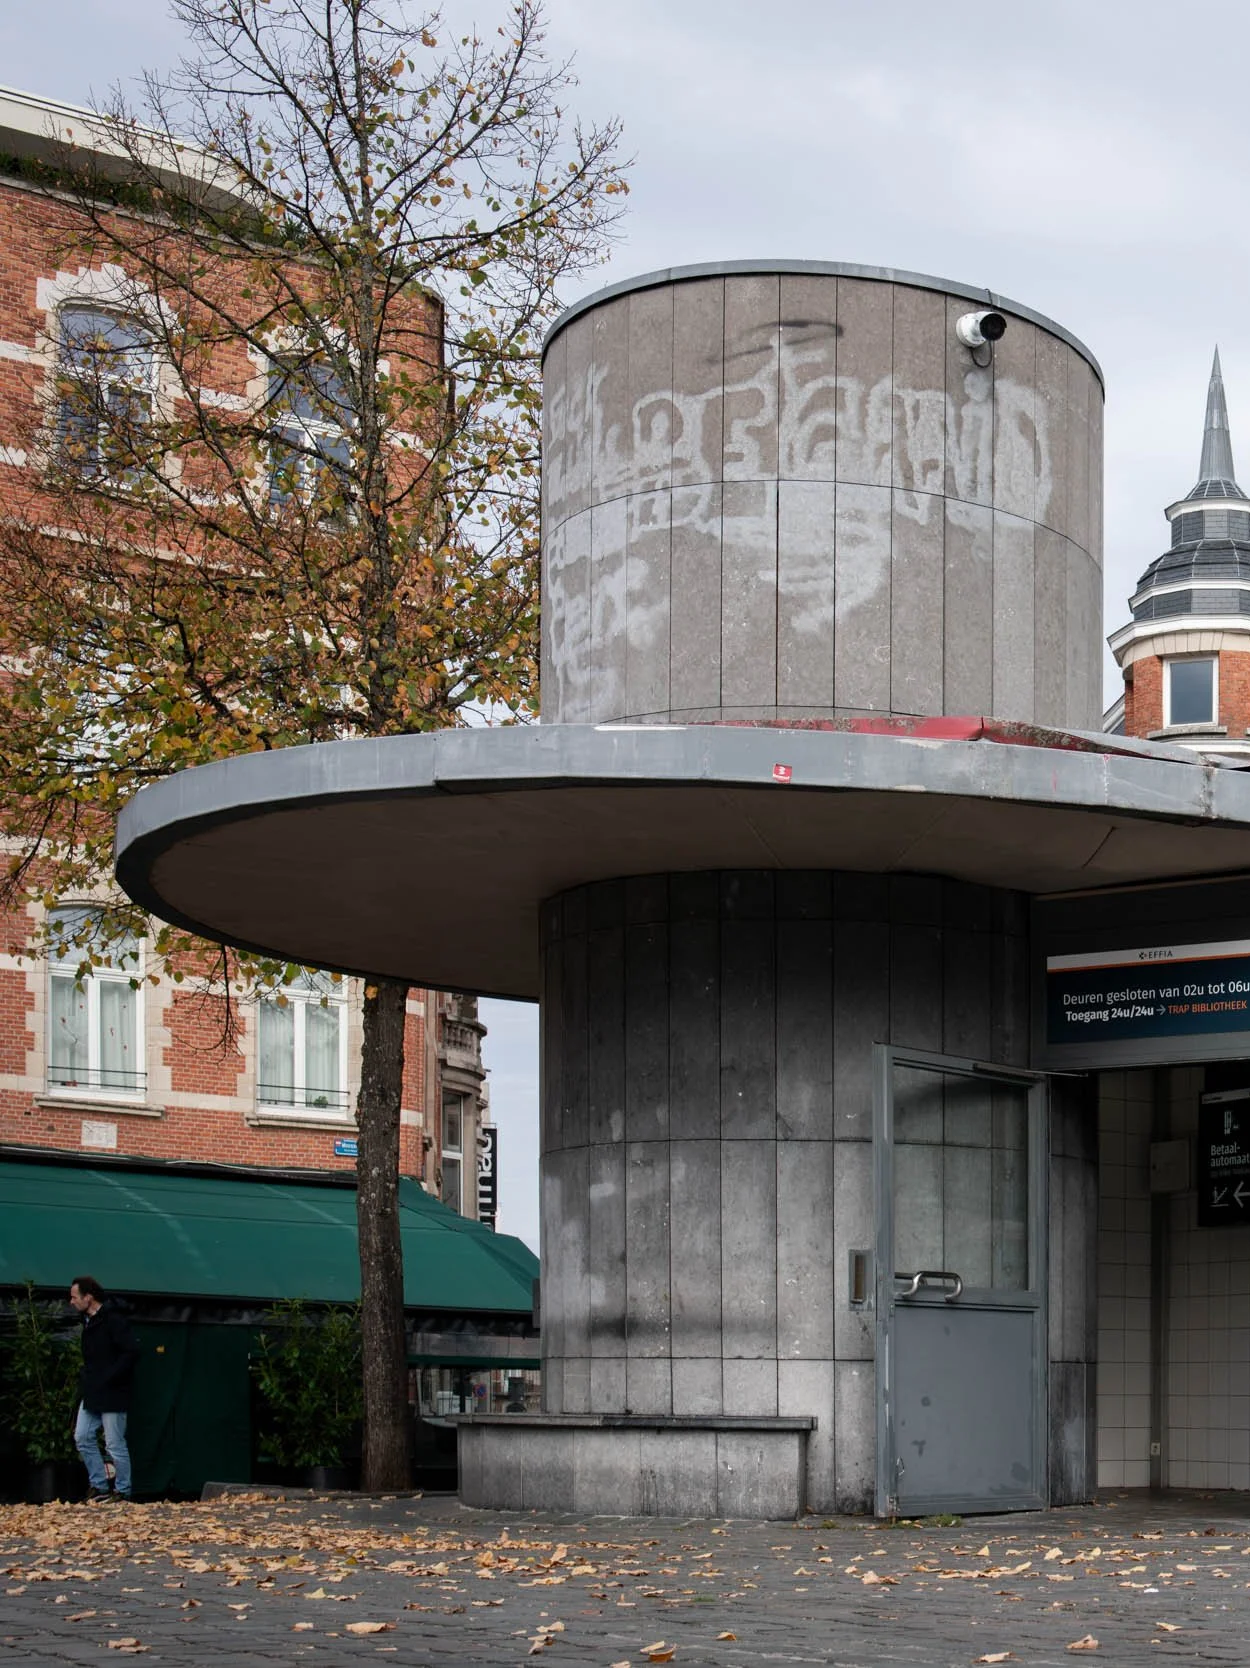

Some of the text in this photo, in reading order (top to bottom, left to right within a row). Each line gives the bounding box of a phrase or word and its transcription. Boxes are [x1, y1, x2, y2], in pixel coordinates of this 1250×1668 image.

[1148, 950, 1173, 959] EFFIA
[1063, 980, 1250, 1006] Deuren gesloten van 02u tot 06u
[1065, 1000, 1248, 1023] Toegang 24u/24u TRAP BIBLIOTHEEK
[1210, 1142, 1241, 1156] Betaal-
[1210, 1153, 1250, 1167] automaat
